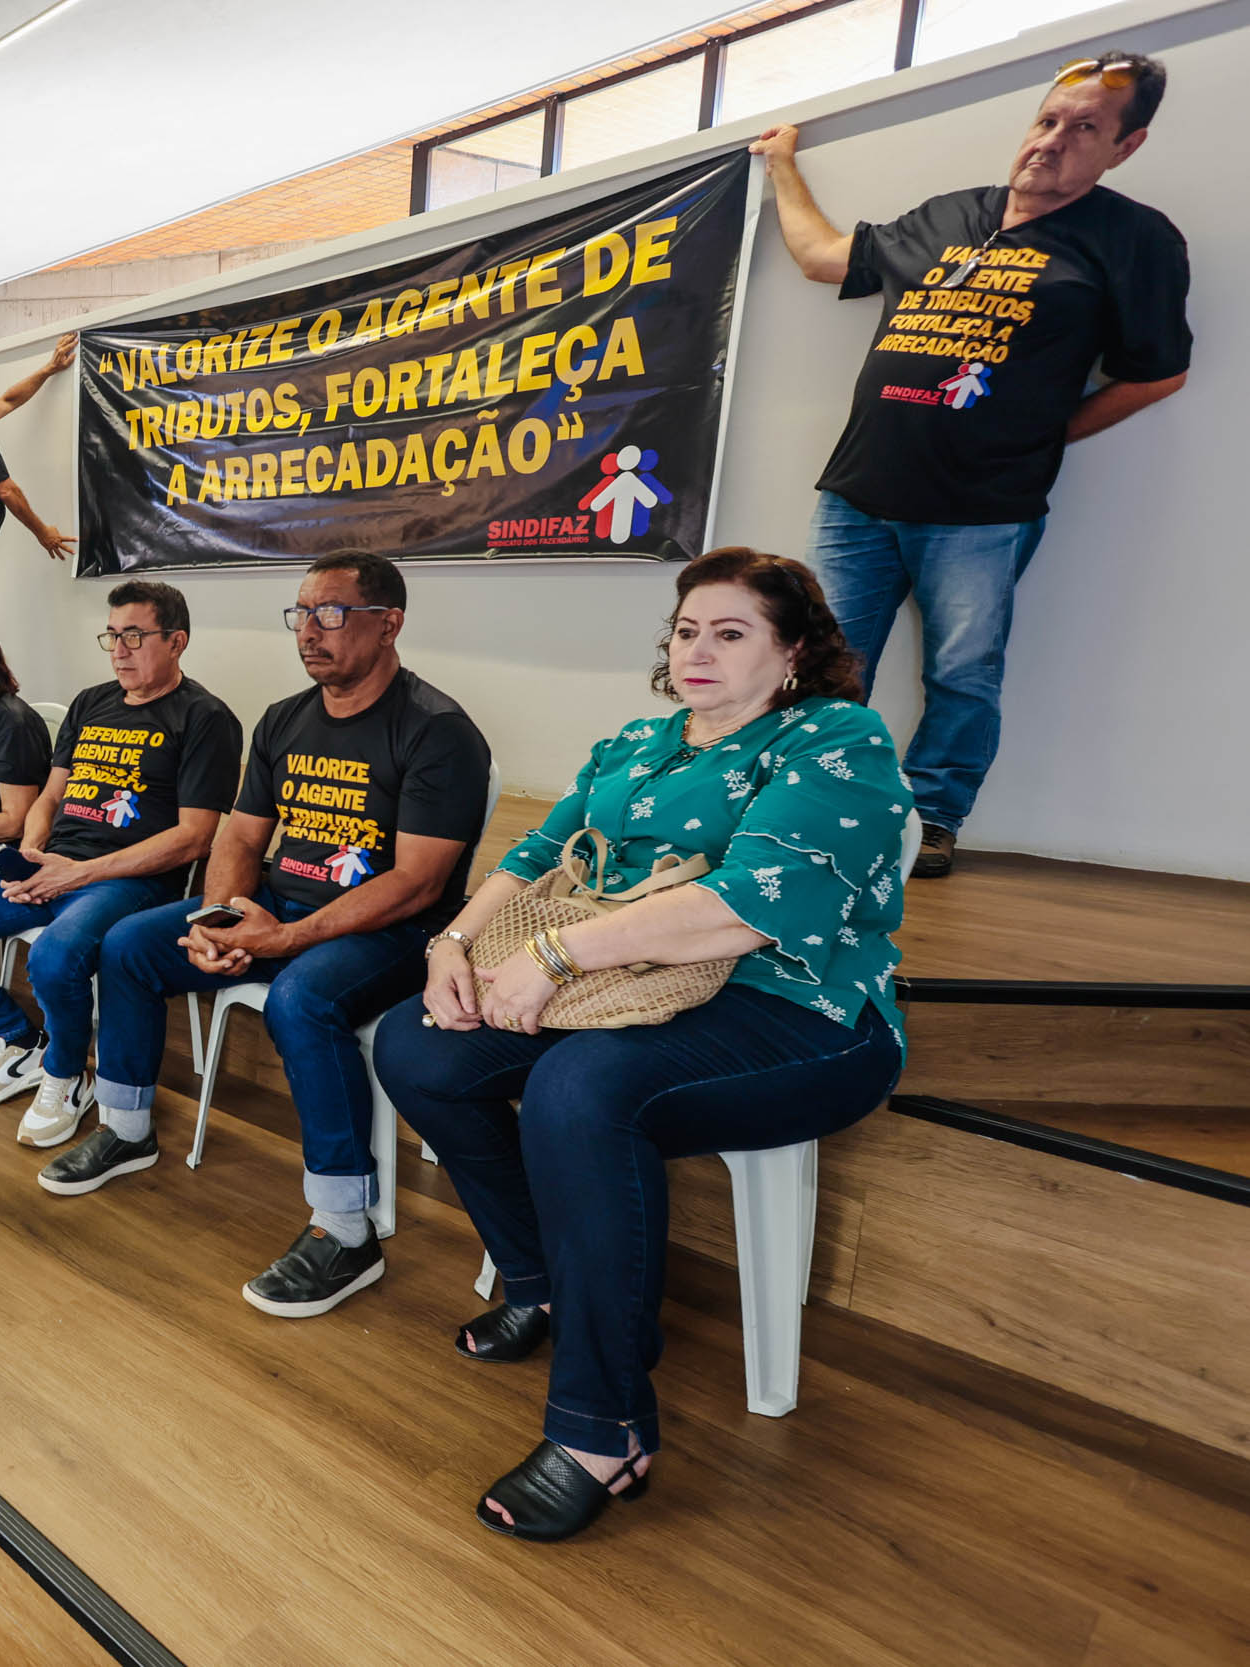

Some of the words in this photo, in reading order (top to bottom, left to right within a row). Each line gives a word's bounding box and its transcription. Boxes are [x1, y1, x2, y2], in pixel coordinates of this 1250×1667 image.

[922, 267, 946, 286] O
[100, 317, 302, 392] “VALORIZE
[307, 309, 343, 355] O
[350, 247, 567, 343] AGENTE
[582, 215, 678, 297] DE
[896, 290, 928, 311] DE
[925, 290, 1036, 327] TRIBUTOS,
[888, 313, 996, 341] FORTALEÇA
[993, 324, 1014, 343] A
[125, 382, 312, 451] TRIBUTOS,
[324, 316, 646, 423] FORTALEÇA
[880, 384, 943, 402] SINDIFAZ
[166, 463, 189, 507] A
[487, 515, 591, 541] SINDIFAZ
[78, 725, 150, 746] DEFENDER
[149, 731, 165, 748] O
[119, 747, 144, 766] DE
[287, 753, 370, 785] VALORIZE
[281, 779, 295, 801] O
[295, 782, 368, 813] AGENTE
[64, 802, 105, 820] SINDIFAZ
[279, 856, 330, 878] SINDIFAZ
